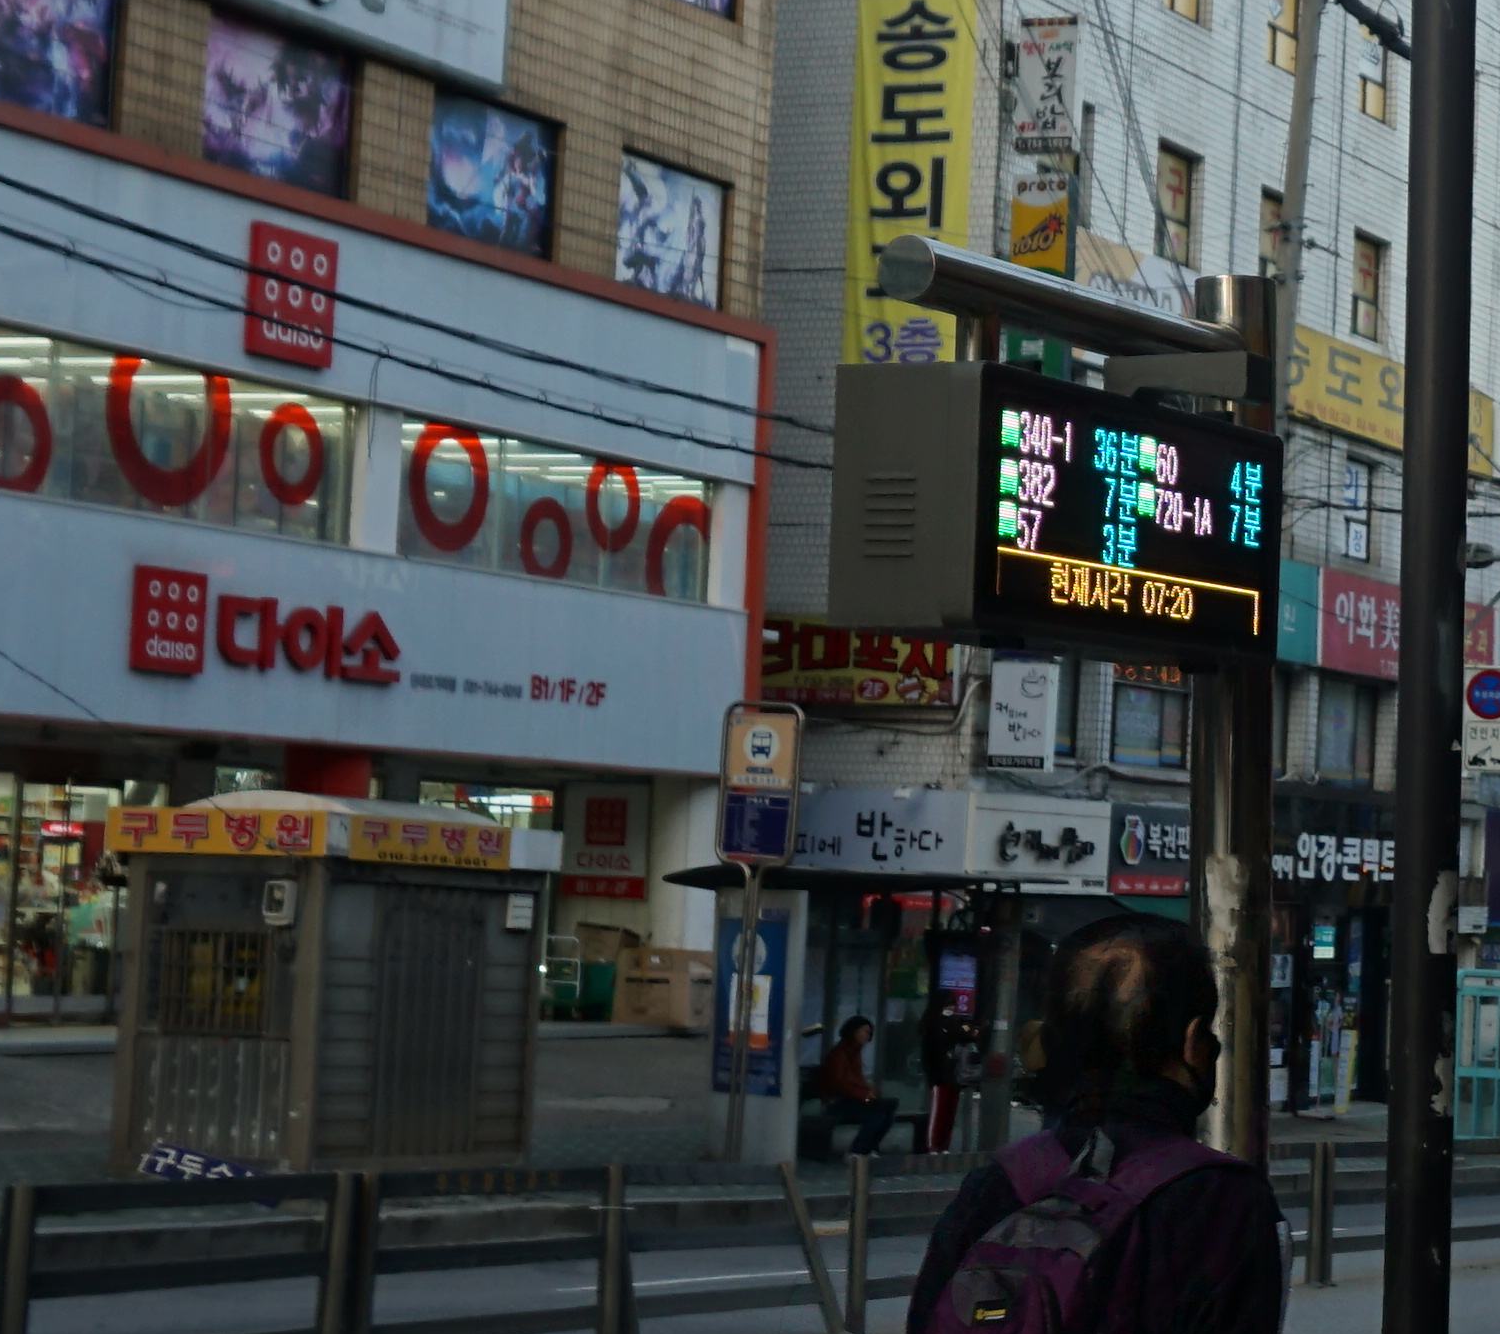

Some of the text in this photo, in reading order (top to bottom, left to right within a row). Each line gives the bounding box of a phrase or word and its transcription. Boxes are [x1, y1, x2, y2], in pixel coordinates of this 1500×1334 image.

[866, 0, 956, 297] 송도외
[1017, 178, 1067, 194] proto
[1019, 411, 1263, 505] 340-1 36분 60 4분
[1018, 459, 1261, 549] 382 7분 720-1A 7분
[1017, 508, 1136, 568] 57 3분
[1050, 563, 1193, 620] 현재시각 07:20
[145, 635, 196, 661] daiso
[217, 594, 401, 684] 다이소
[120, 811, 313, 850] 구두병원
[857, 811, 944, 861] 반하다
